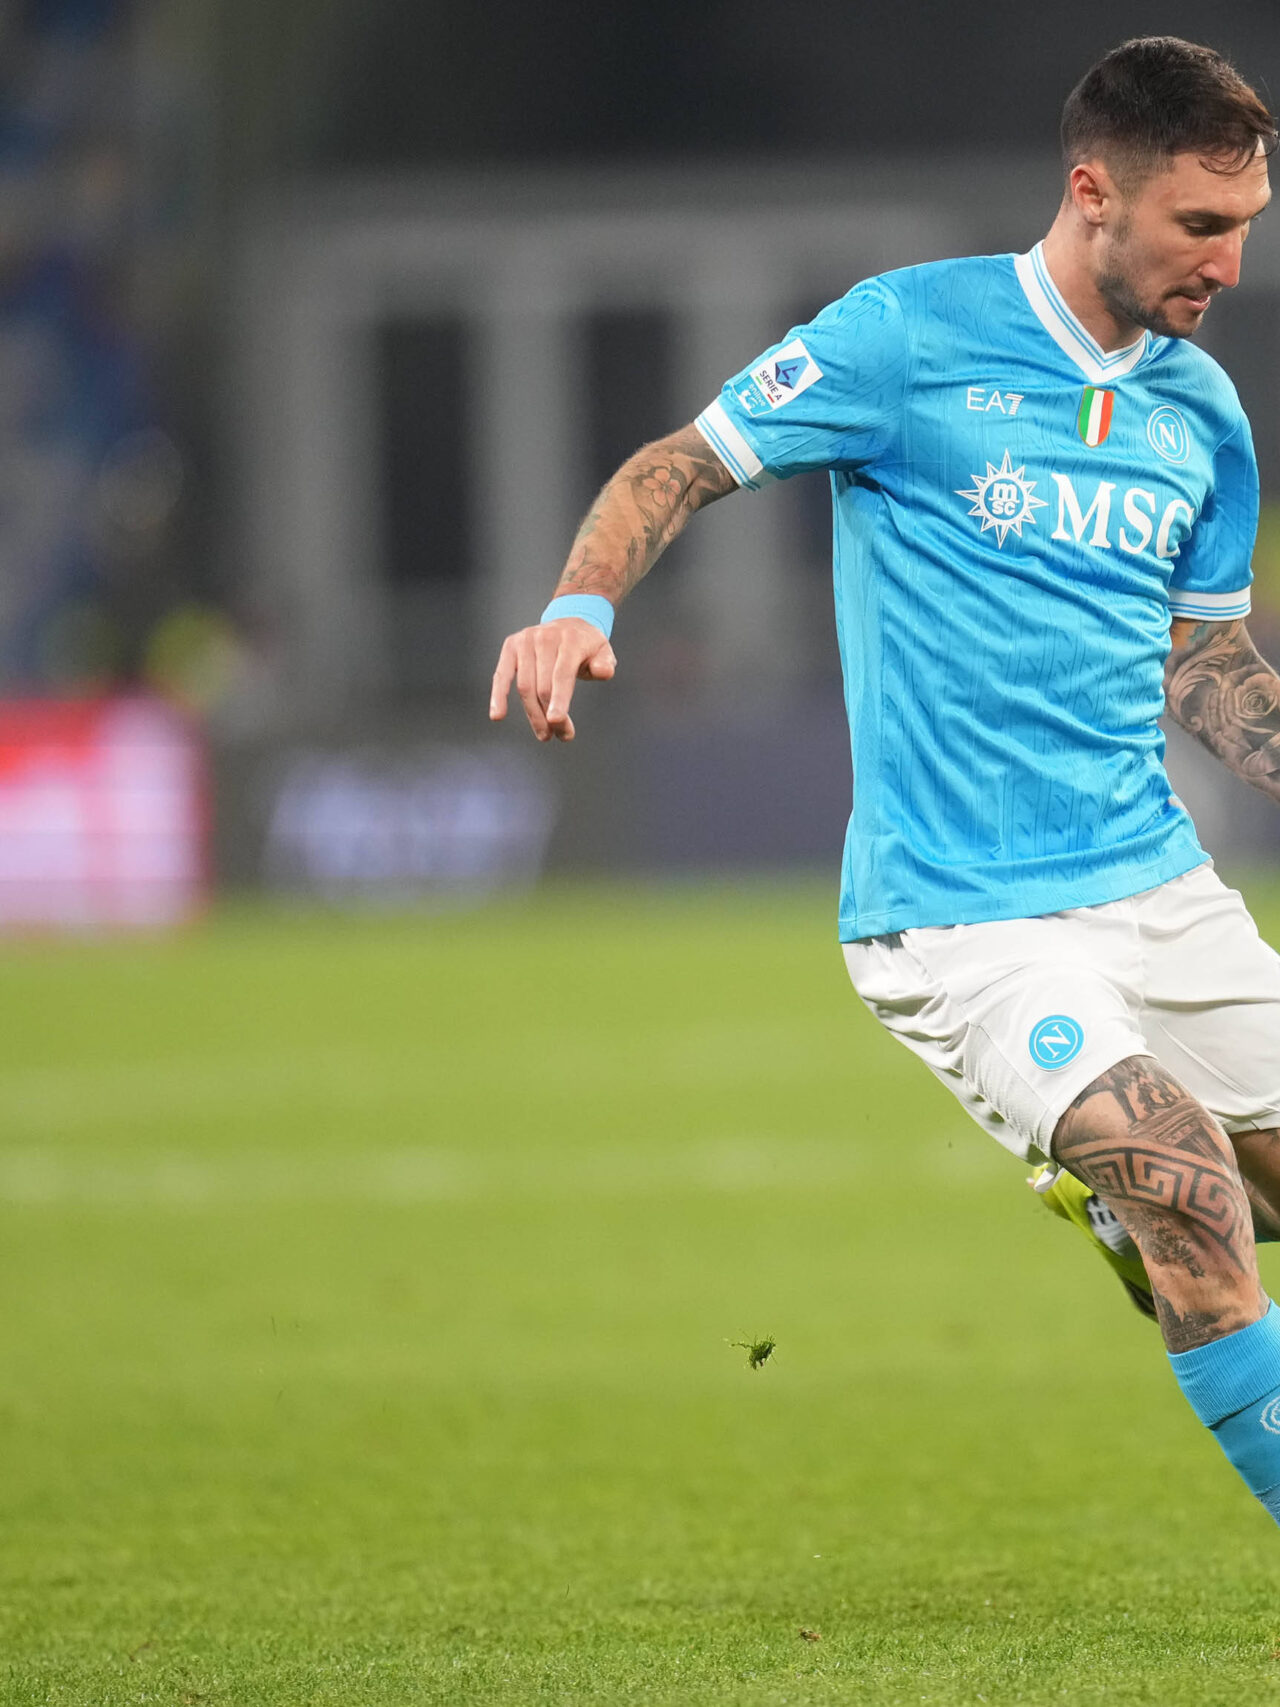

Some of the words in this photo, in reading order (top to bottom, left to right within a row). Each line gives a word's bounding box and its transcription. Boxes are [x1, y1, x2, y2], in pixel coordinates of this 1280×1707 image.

[760, 370, 779, 394] SERIE
[966, 387, 1024, 416] EA7
[1158, 423, 1177, 450] N
[1051, 472, 1195, 560] MSC
[1039, 1025, 1071, 1058] N
